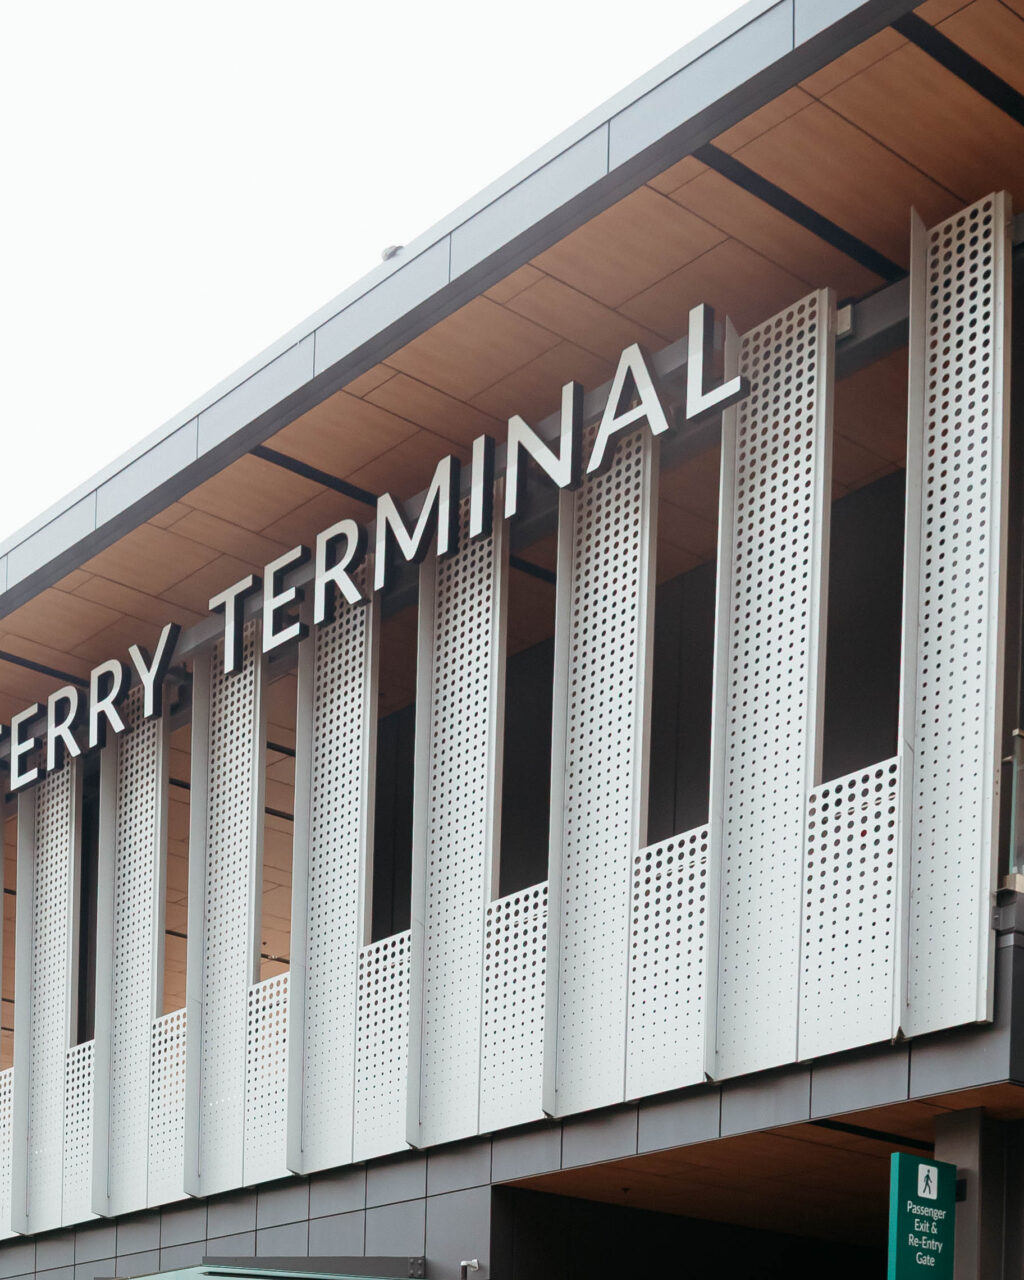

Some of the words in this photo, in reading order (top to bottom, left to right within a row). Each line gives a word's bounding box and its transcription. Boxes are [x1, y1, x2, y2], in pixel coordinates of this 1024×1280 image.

[208, 302, 744, 675] TERMINAL
[906, 1199, 947, 1221] Passenger
[914, 1218, 930, 1233] Exit
[930, 1221, 938, 1235] &
[907, 1233, 943, 1254] Re-Entry
[915, 1251, 936, 1267] Gate
